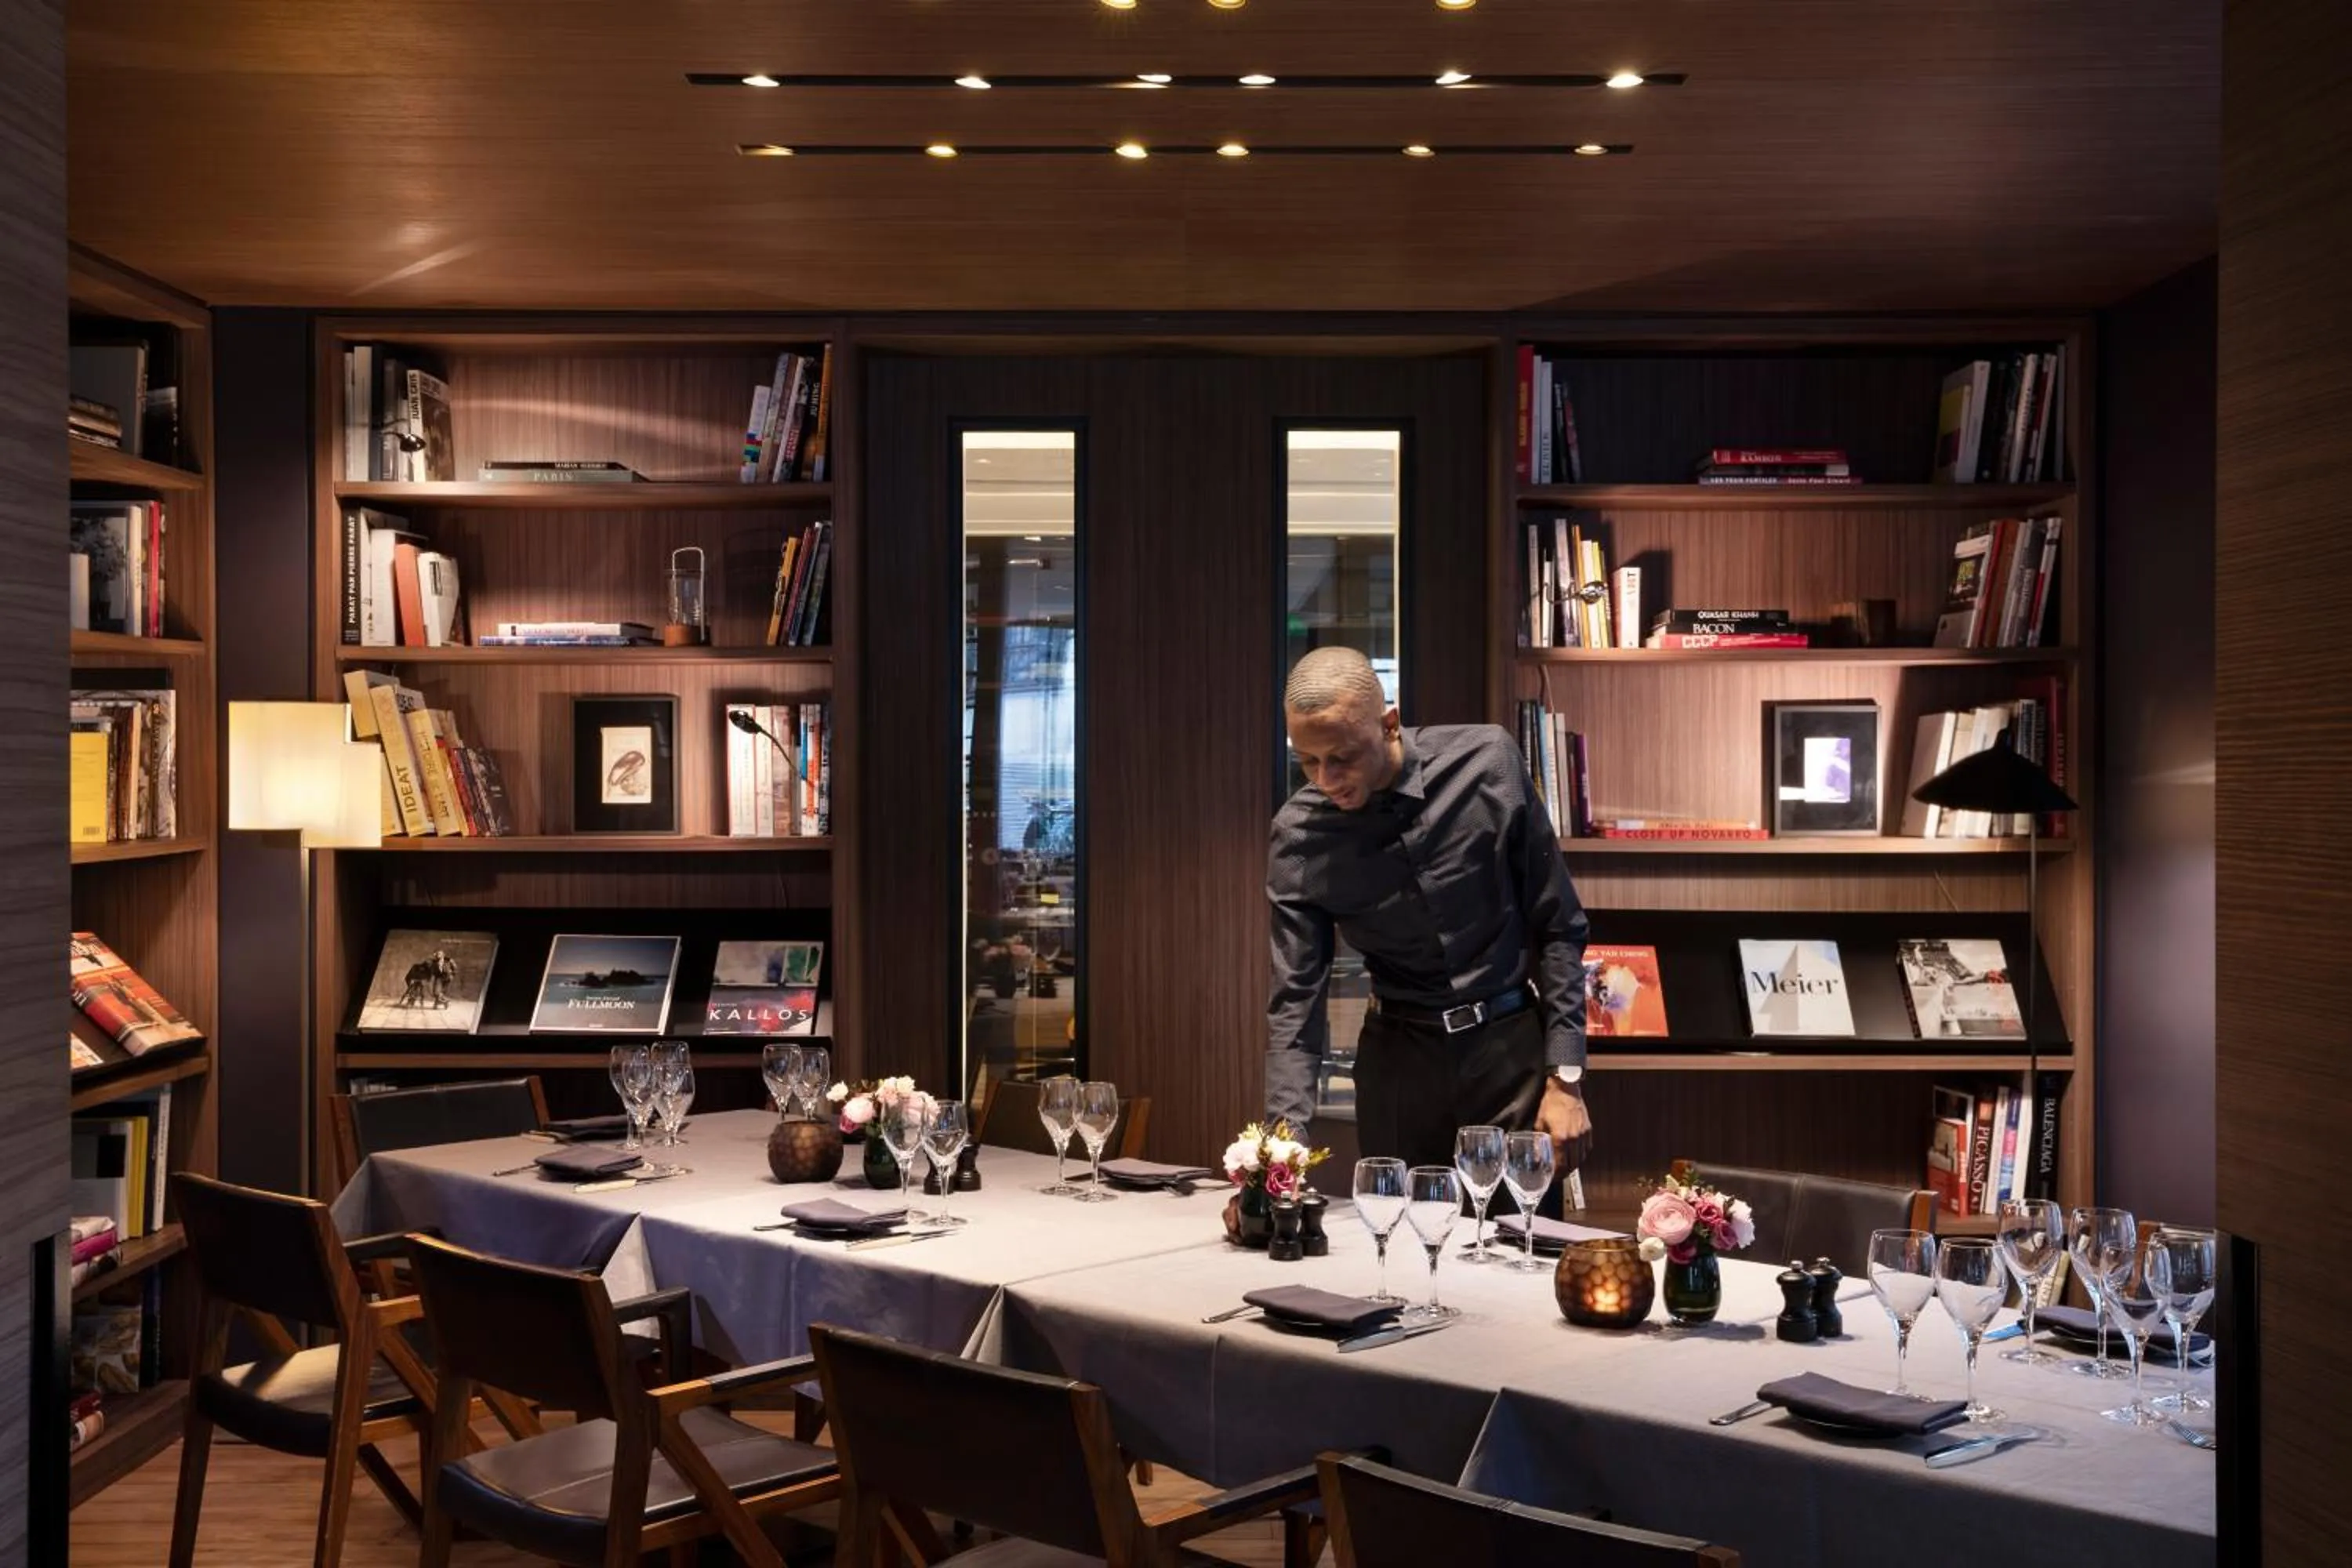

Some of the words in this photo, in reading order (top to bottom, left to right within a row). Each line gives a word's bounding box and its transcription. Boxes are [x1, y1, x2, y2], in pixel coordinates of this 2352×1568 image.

[534, 473, 573, 482] PARIS
[347, 515, 356, 544] PARAT
[347, 545, 356, 575] PIERRE
[347, 576, 356, 593] PAR
[347, 595, 356, 624] PARAT
[1697, 611, 1730, 619] QUASAR
[1693, 623, 1735, 634] BACON
[1682, 634, 1719, 648] CCCP
[395, 764, 418, 814] IDEAT
[1625, 829, 1662, 839] CLOSE
[1670, 829, 1685, 840] UP
[1751, 971, 1838, 994] Meier
[568, 998, 636, 1009] FULLMOON
[709, 1009, 808, 1021] KALLOS
[2039, 1097, 2056, 1174] BALENCIAGA
[1971, 1126, 1991, 1192] PICASSO
